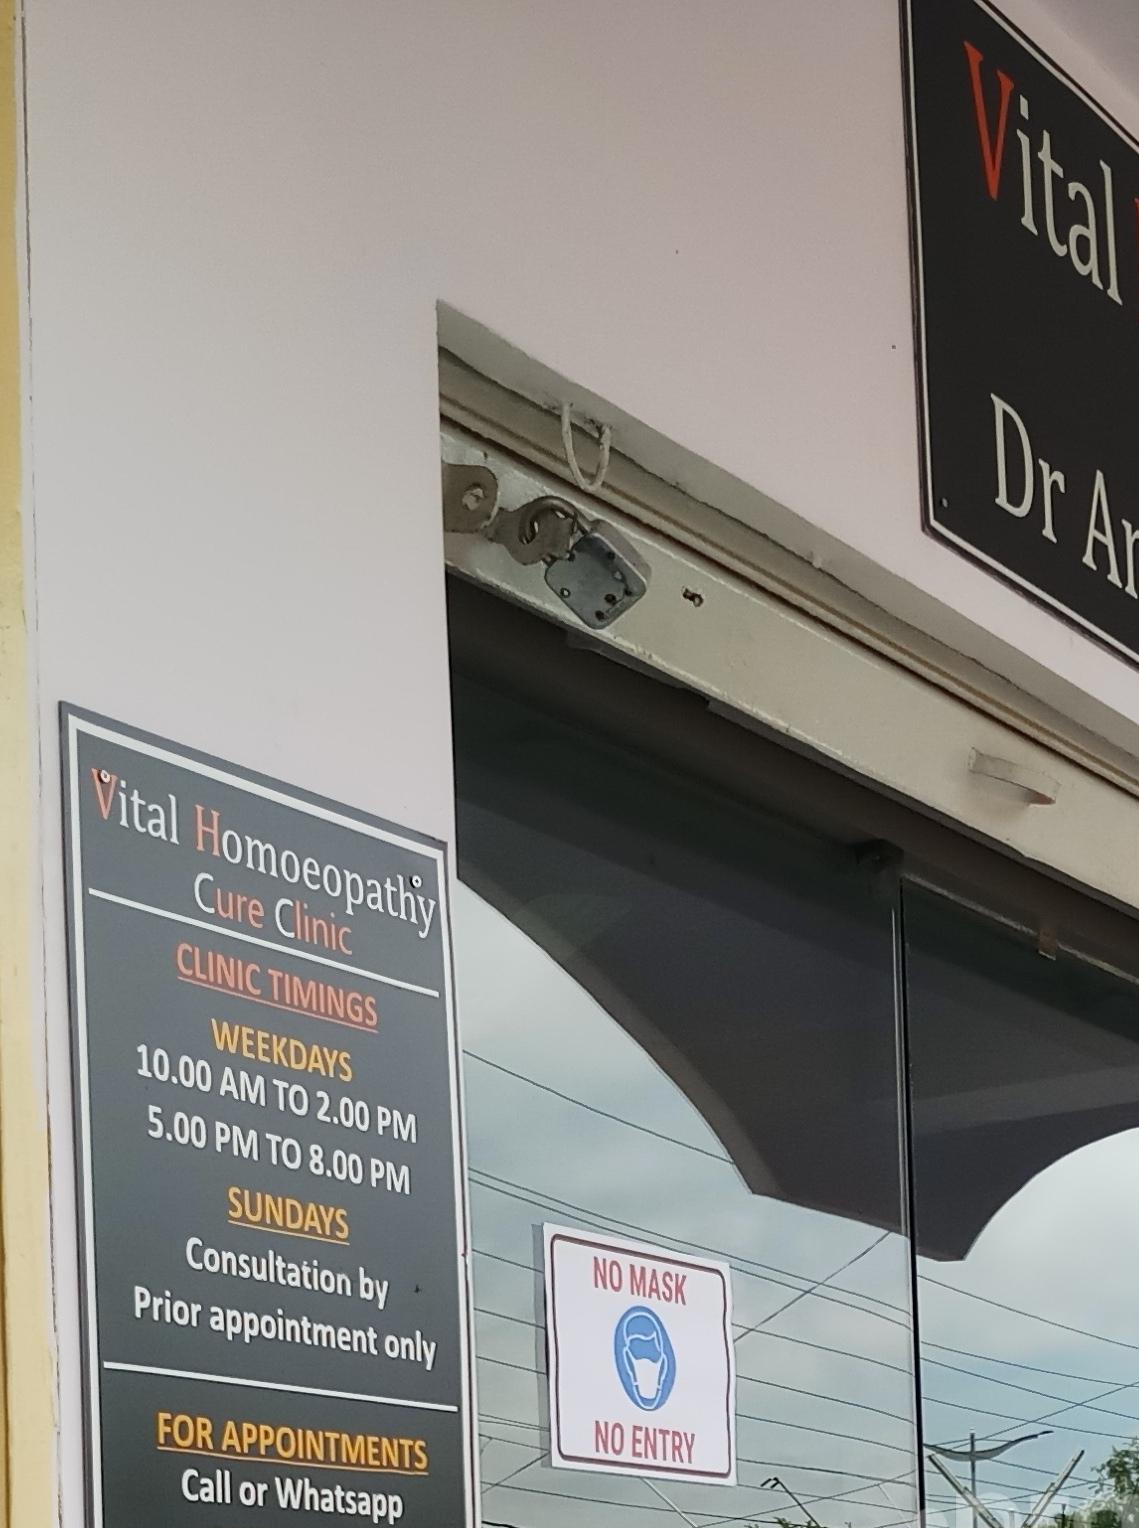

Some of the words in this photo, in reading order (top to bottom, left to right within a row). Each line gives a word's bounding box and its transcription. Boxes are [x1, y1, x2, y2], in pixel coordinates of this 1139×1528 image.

[964, 40, 1123, 306] Vital
[991, 393, 1066, 543] Dr
[91, 768, 179, 845] Vital
[195, 805, 436, 938] Homoeopathy
[194, 872, 264, 928] Cure
[275, 898, 352, 955] Clinic
[176, 942, 261, 995] CLINIC
[268, 969, 378, 1027] TIMINGS
[211, 1018, 352, 1081] WEEKDAYS
[137, 1044, 211, 1092] 10.00
[220, 1067, 266, 1106] AM
[273, 1078, 308, 1116] TO
[316, 1090, 369, 1131] 2.00
[378, 1106, 417, 1143] PM
[148, 1104, 206, 1148] 5.00
[215, 1121, 259, 1161] PM
[265, 1132, 300, 1169] TO
[309, 1144, 364, 1186] 8.00
[370, 1159, 410, 1195] PM
[228, 1186, 349, 1239] SUNDAYS
[185, 1237, 352, 1297] Consultation
[359, 1266, 389, 1309] by
[593, 1256, 623, 1292] NO
[629, 1263, 687, 1305] MASK
[134, 1286, 202, 1327] Prior
[209, 1304, 378, 1356] appointment
[384, 1330, 436, 1370] only
[157, 1411, 214, 1449] FOR
[222, 1420, 428, 1470] APPOINTMENTS
[595, 1420, 624, 1455] NO
[632, 1425, 696, 1464] ENTRY
[181, 1468, 231, 1505] Call
[239, 1479, 267, 1508] or
[276, 1477, 402, 1524] Whatsapp
